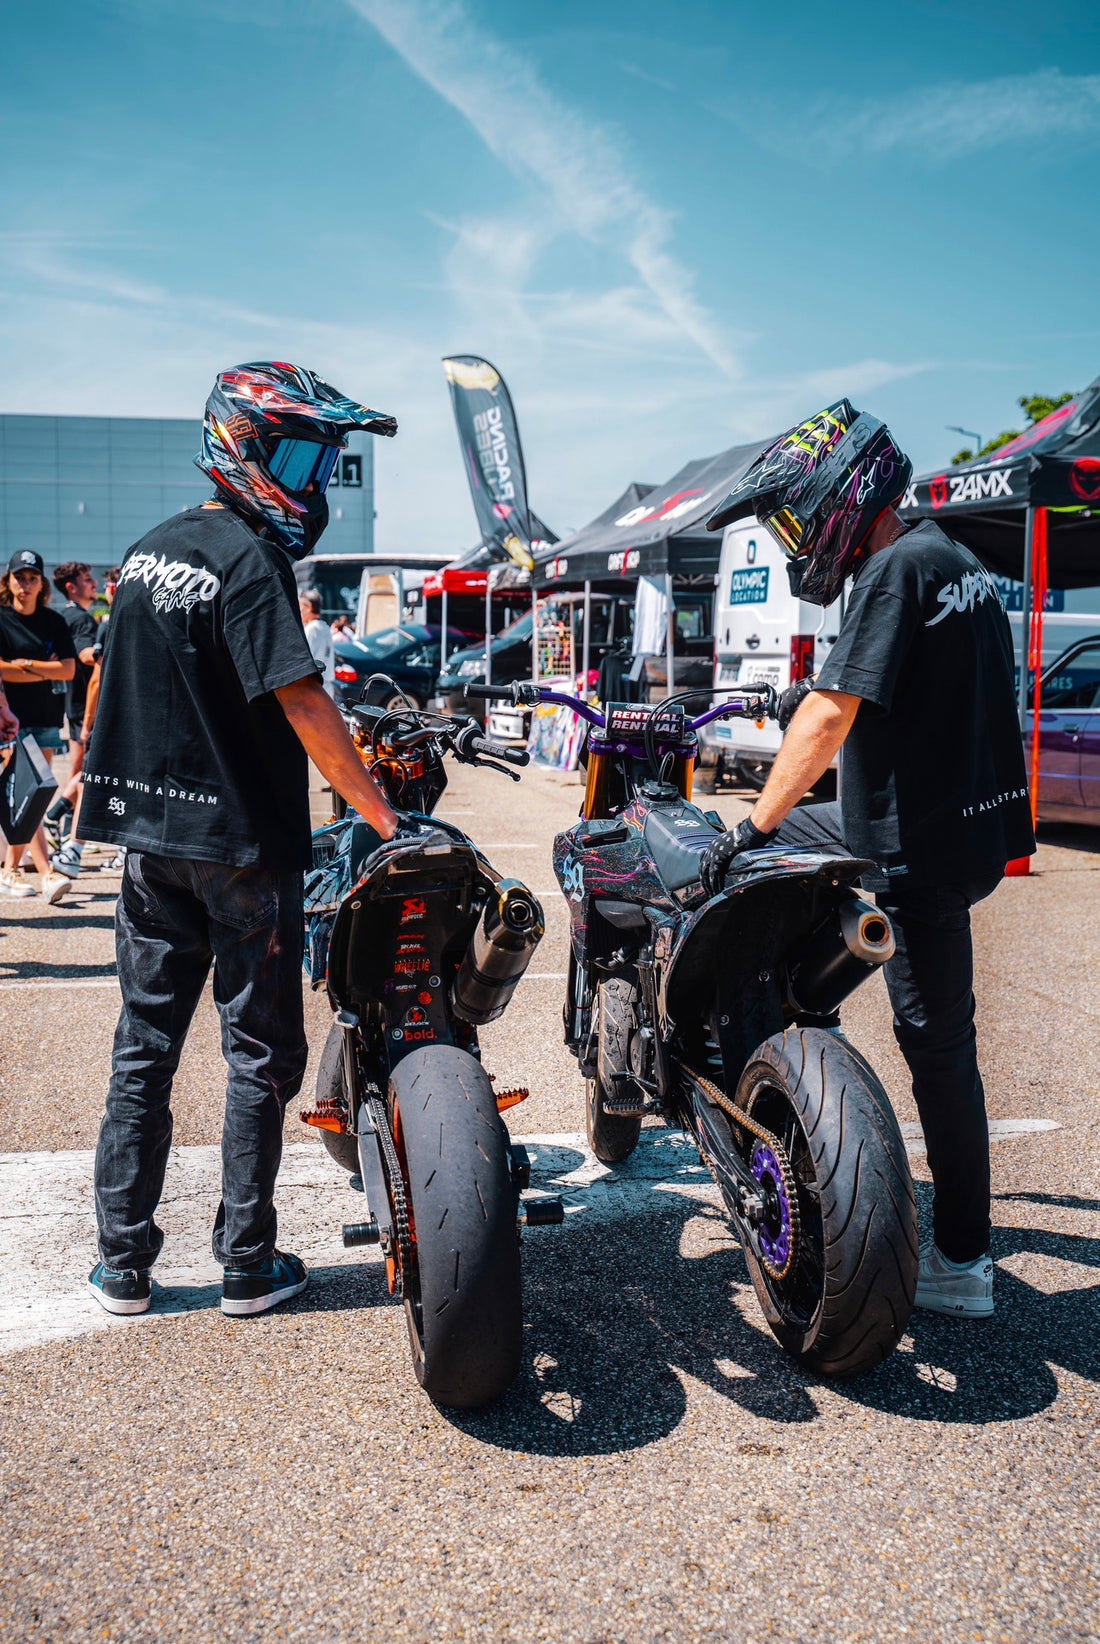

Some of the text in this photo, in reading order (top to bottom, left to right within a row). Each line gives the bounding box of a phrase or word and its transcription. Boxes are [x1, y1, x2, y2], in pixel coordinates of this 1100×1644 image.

[950, 469, 1013, 503] 24MX
[733, 571, 766, 590] OLYMPIC
[152, 587, 200, 614] GANG
[732, 590, 765, 602] LOCATION
[82, 772, 217, 805] TARTS WITH A DREAM
[963, 806, 974, 817] IT
[979, 799, 998, 812] ALL
